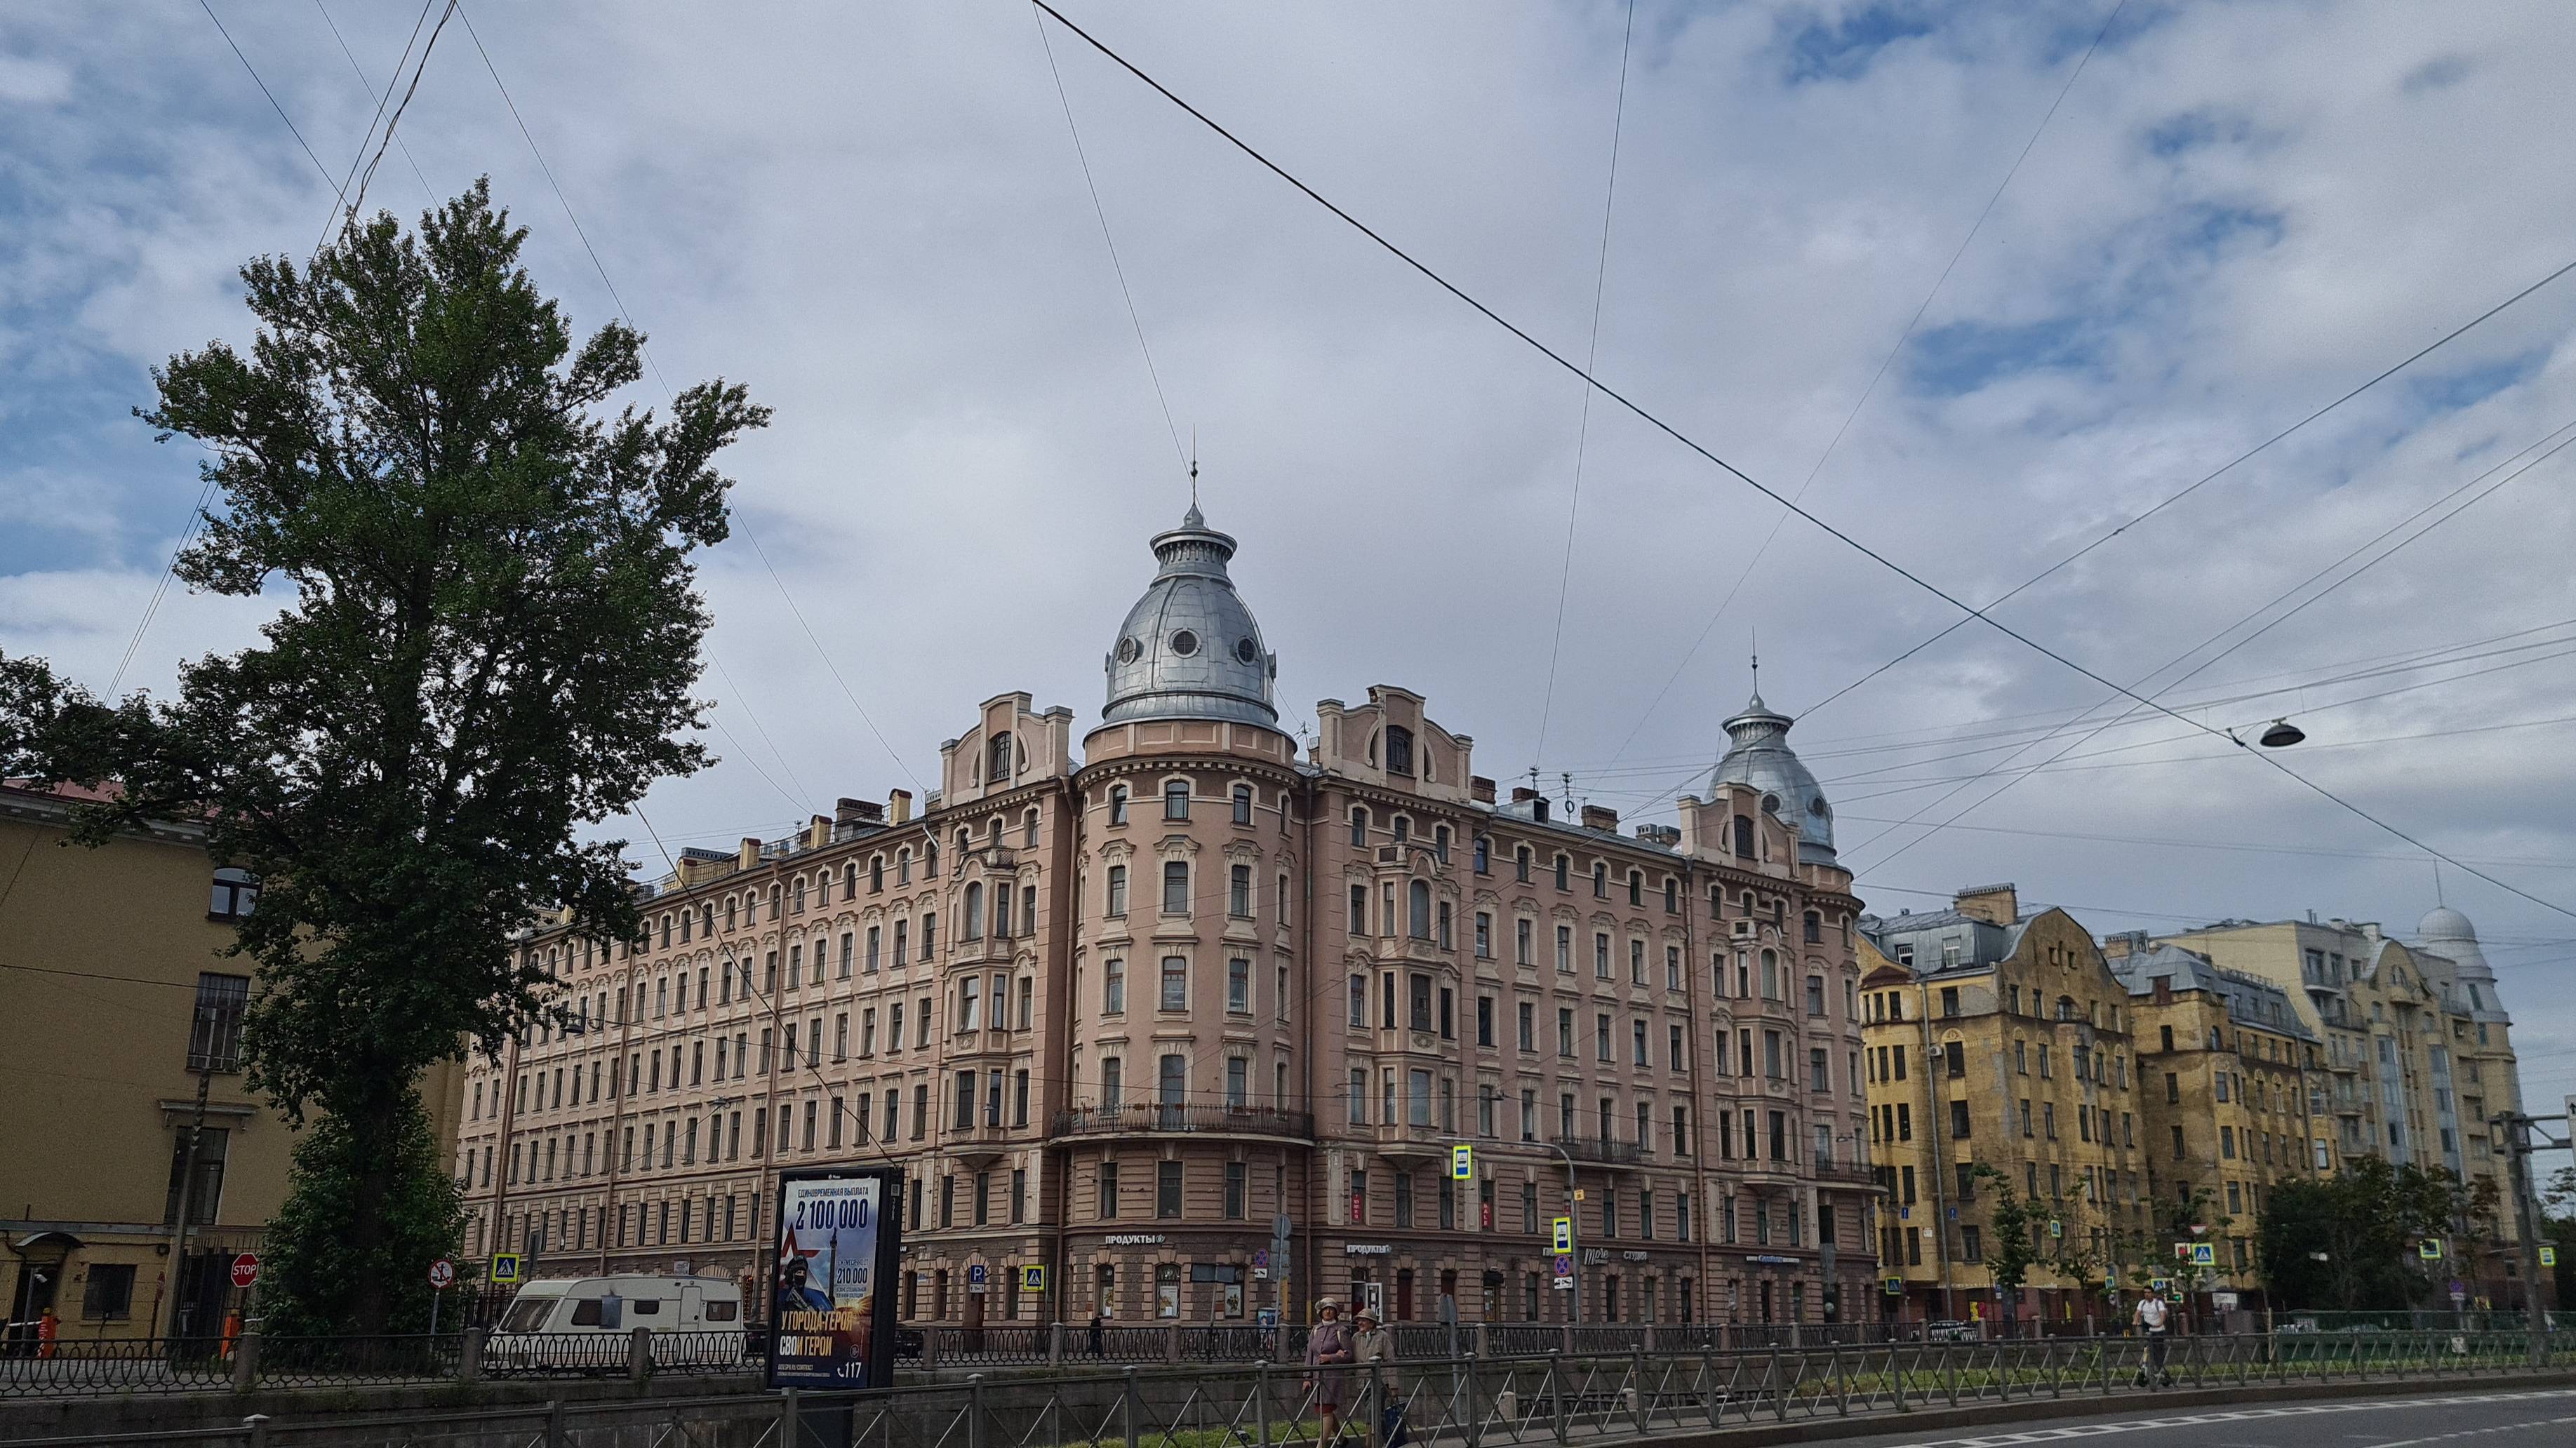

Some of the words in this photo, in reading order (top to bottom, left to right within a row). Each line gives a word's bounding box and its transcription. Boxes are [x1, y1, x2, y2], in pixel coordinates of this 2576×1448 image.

[798, 1187, 843, 1198] ЕДИНОВРЕМЕННАЯ
[844, 1186, 869, 1196] ВЫПЛАТА
[795, 1200, 806, 1230] 2
[810, 1200, 835, 1230] 100
[839, 1198, 869, 1228] 000
[1105, 1235, 1155, 1245] ПРОДУКТЫ
[1347, 1245, 1387, 1254] ПРОДУКТЫ
[1623, 1250, 1648, 1261] СТУДИЯ
[233, 1264, 257, 1275] STOP
[836, 1268, 851, 1284] 210
[853, 1268, 868, 1284] 000
[781, 1310, 788, 1331] У
[787, 1310, 854, 1334] ГОРОДА-ГЕРОЯ
[779, 1335, 803, 1356] СВОИ
[803, 1336, 833, 1357] ГЕРОИ
[845, 1362, 862, 1379] 117
